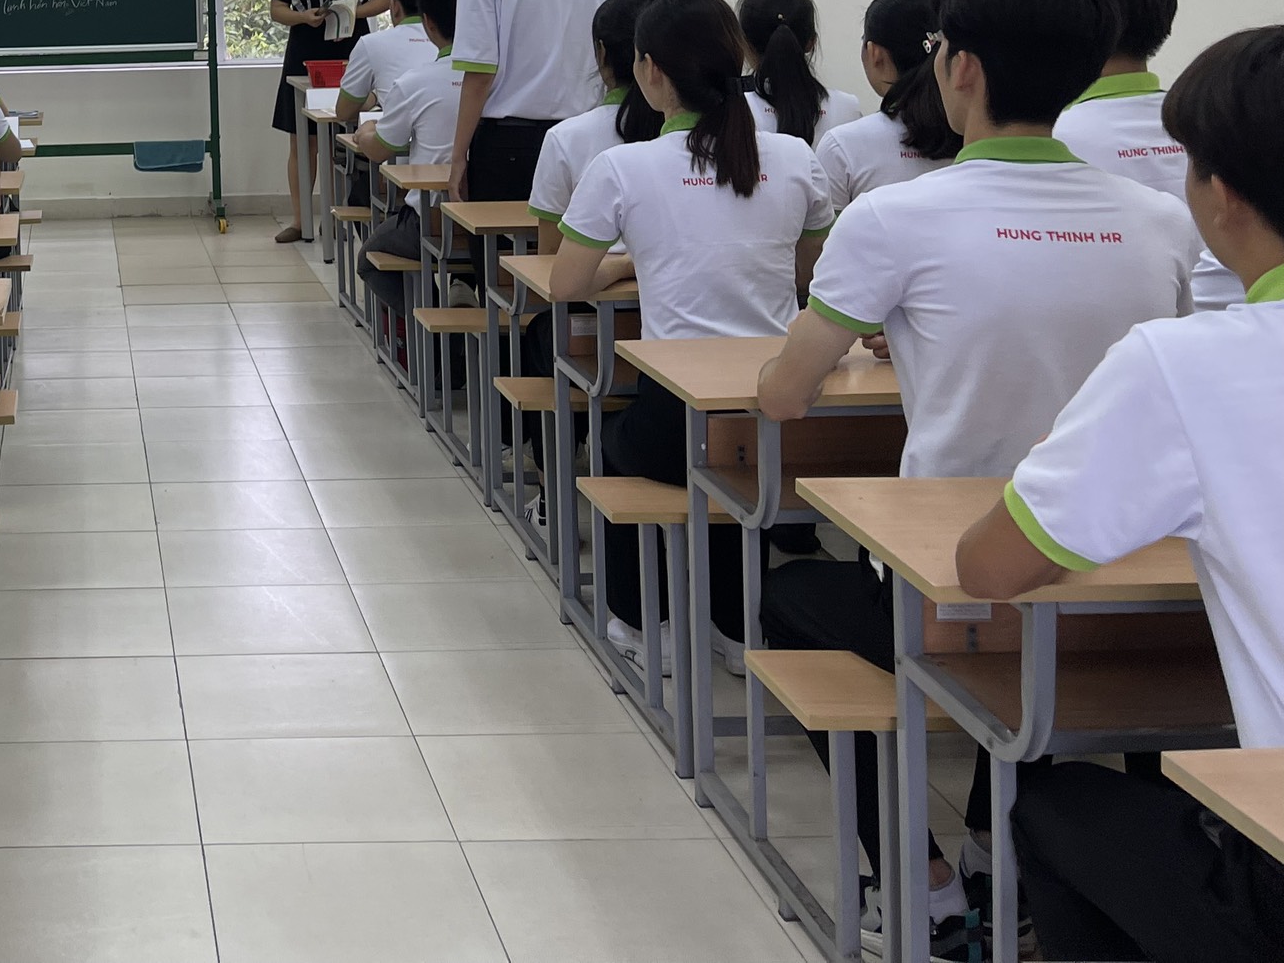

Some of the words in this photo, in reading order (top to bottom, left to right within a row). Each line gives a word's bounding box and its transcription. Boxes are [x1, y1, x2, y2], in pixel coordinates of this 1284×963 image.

[1118, 148, 1148, 158] HUNG
[1150, 145, 1184, 155] THINH
[683, 177, 714, 186] HUNG
[996, 228, 1042, 241] HUNG
[1046, 231, 1095, 243] THINH
[1100, 232, 1123, 243] HR
